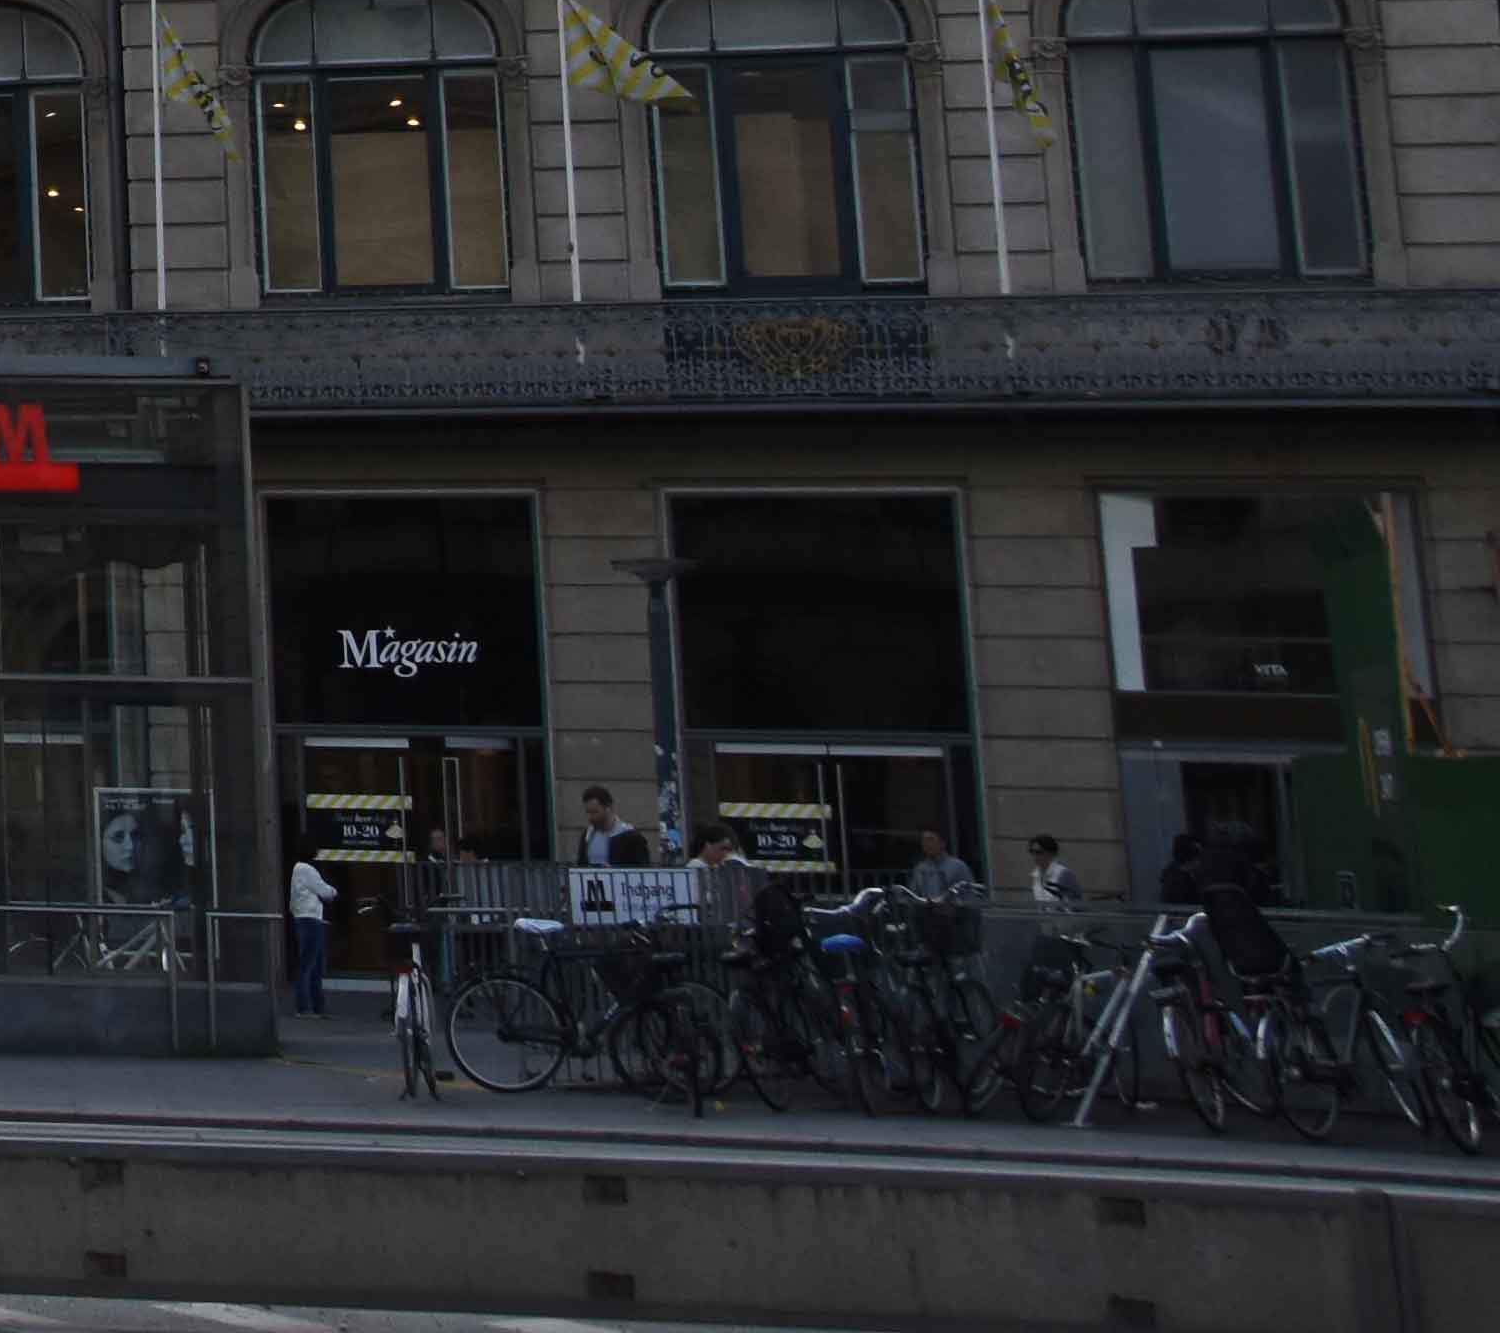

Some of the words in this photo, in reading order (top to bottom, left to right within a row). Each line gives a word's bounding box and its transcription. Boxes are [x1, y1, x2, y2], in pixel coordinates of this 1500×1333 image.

[336, 628, 478, 677] Magasin
[343, 824, 380, 838] 10-20
[757, 833, 797, 848] 10-20
